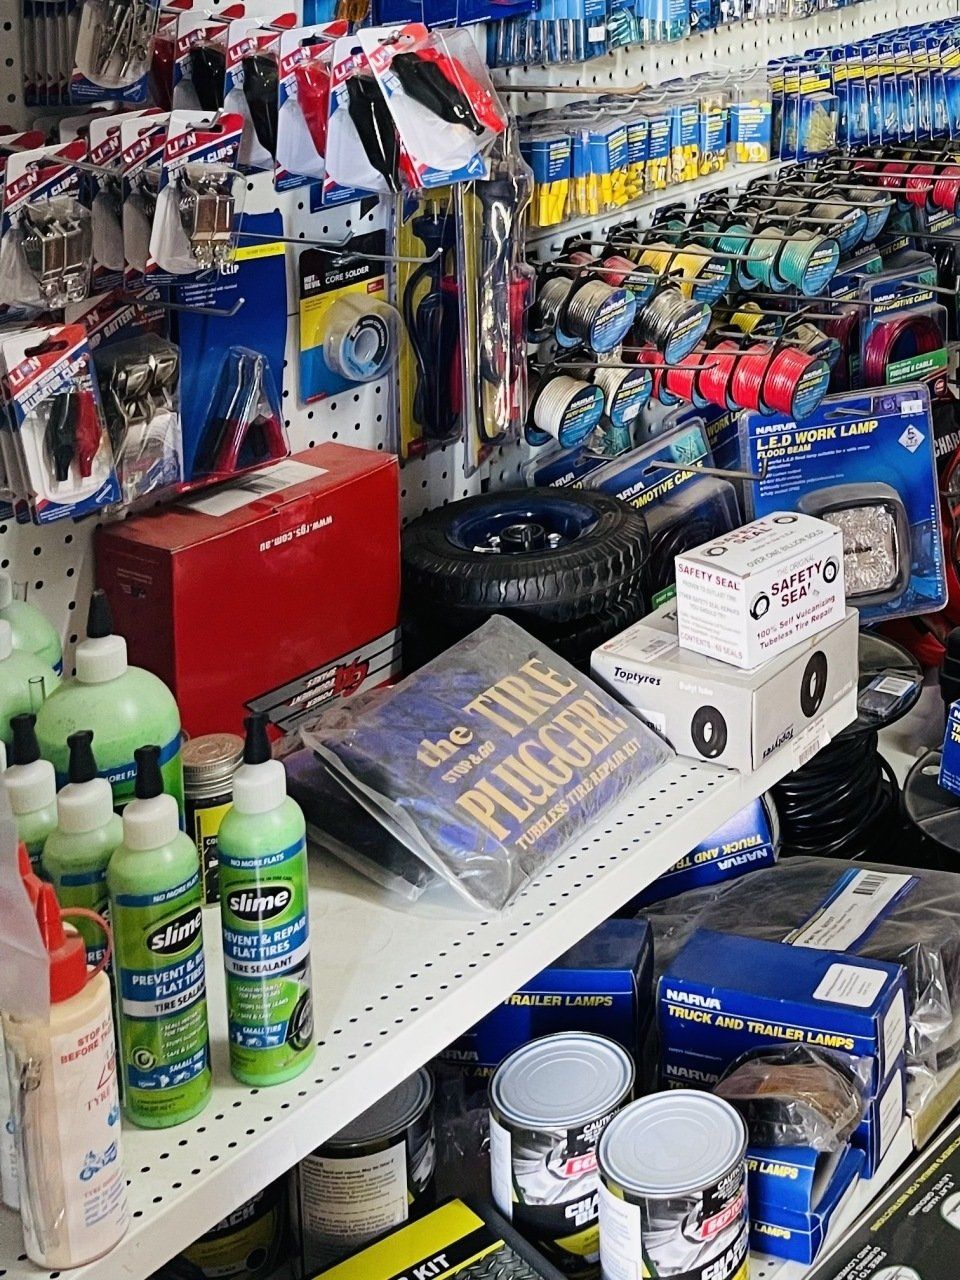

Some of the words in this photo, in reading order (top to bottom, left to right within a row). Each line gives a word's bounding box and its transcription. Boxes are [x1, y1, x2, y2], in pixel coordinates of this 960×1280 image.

[206, 148, 233, 163] CLIPS
[325, 273, 343, 284] CORE
[345, 265, 369, 279] SOLDER
[874, 294, 894, 303] NARVA
[914, 292, 933, 304] CABLE
[915, 359, 933, 371] CABLE
[756, 422, 797, 435] NARVA
[795, 427, 836, 444] WORK
[841, 420, 878, 436] LAMP
[757, 448, 785, 459] FLOOD
[787, 444, 811, 454] BEAM
[259, 515, 333, 552] www.rgs.com.au
[805, 530, 824, 540] SOLD
[678, 563, 712, 584] SAFETY
[715, 573, 740, 591] SEAL
[771, 561, 822, 596] SAFETY
[779, 618, 794, 628] Self
[796, 595, 835, 621] Vulcanizing
[760, 630, 793, 650] Tubeless
[795, 620, 809, 632] Tire
[811, 606, 833, 623] Repair
[614, 667, 661, 686] Toptyres
[416, 723, 473, 768] the
[463, 658, 578, 739] TIRE
[517, 799, 570, 851] TUBELESS
[567, 779, 595, 804] TIRE
[590, 753, 628, 790] REPAIR
[624, 737, 642, 763] KIT
[723, 834, 764, 856] TRUCK
[242, 858, 262, 867] MORE
[263, 854, 285, 864] FLATS
[694, 847, 723, 863] AND
[717, 848, 768, 871] NARVA
[166, 885, 187, 901] MORE
[229, 889, 289, 912] slime
[151, 911, 202, 952] slime
[261, 928, 271, 944] &
[233, 945, 258, 959] FLAT
[259, 941, 290, 958] TIRES
[233, 962, 251, 974] TIRE
[252, 957, 293, 974] SEALANT
[132, 965, 184, 987] PREVENT
[155, 979, 184, 998] FLAT
[155, 998, 176, 1012] TIRE
[504, 993, 561, 1007] TRAILER
[564, 994, 613, 1007] LAMPS
[666, 988, 721, 1010] NARVA
[667, 1005, 711, 1027] TRUCK
[714, 1016, 745, 1031] AND
[746, 1021, 803, 1042] TRAILER
[806, 1031, 854, 1050] LAMPS
[77, 1029, 101, 1046] STOP
[60, 1042, 99, 1064] BEFORE
[666, 1064, 720, 1084] NARVA
[758, 1160, 799, 1179] LAMPS
[931, 1171, 952, 1193] LEVEL
[937, 1179, 955, 1197] FLAT
[906, 1189, 935, 1218] GROUND
[754, 1222, 791, 1240] LAMPS
[412, 1253, 450, 1280] KIT
